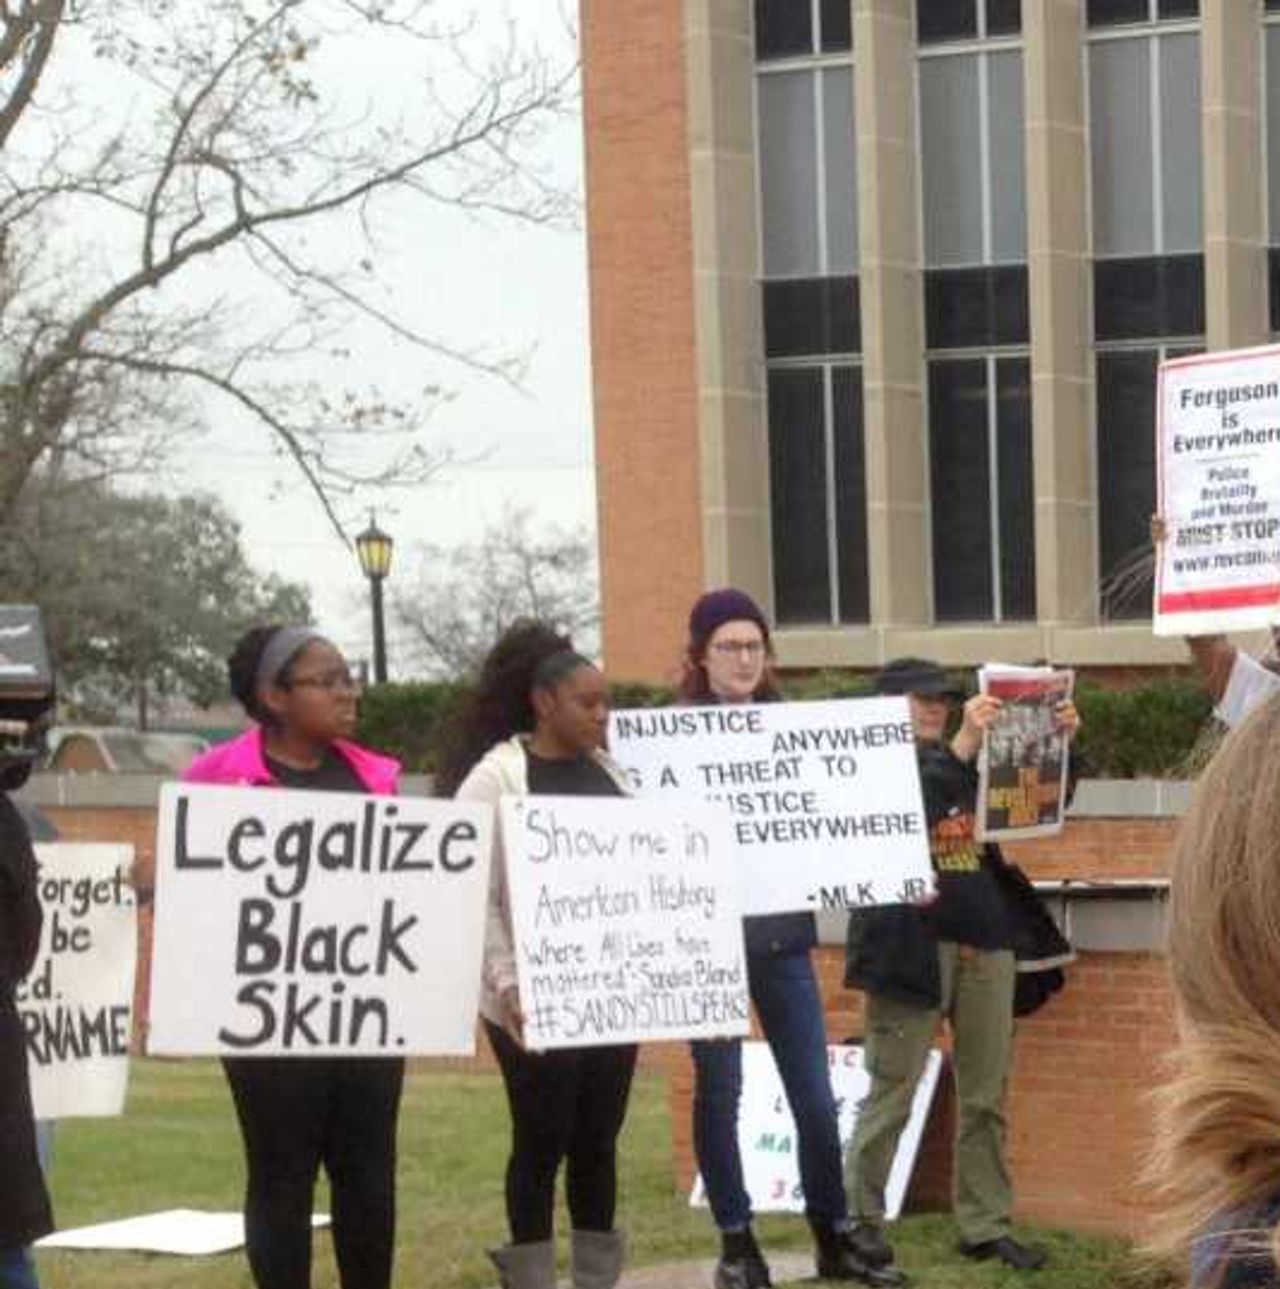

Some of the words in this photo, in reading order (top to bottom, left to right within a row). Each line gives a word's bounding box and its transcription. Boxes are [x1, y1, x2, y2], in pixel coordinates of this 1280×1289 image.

[1180, 381, 1279, 409] Ferguson
[1221, 411, 1239, 429] is
[616, 709, 765, 740] INJUSTICE
[771, 720, 916, 755] ANYWHERE
[660, 763, 679, 789] A
[698, 755, 803, 788] THREAT
[822, 754, 858, 778] TO
[630, 830, 669, 856] me
[736, 811, 921, 846] EVERYWHERE
[173, 797, 478, 899] Legalize
[533, 884, 640, 928] American
[649, 874, 717, 920] History
[51, 910, 92, 953] be
[235, 898, 419, 977] Black
[218, 980, 405, 1048] Skin.
